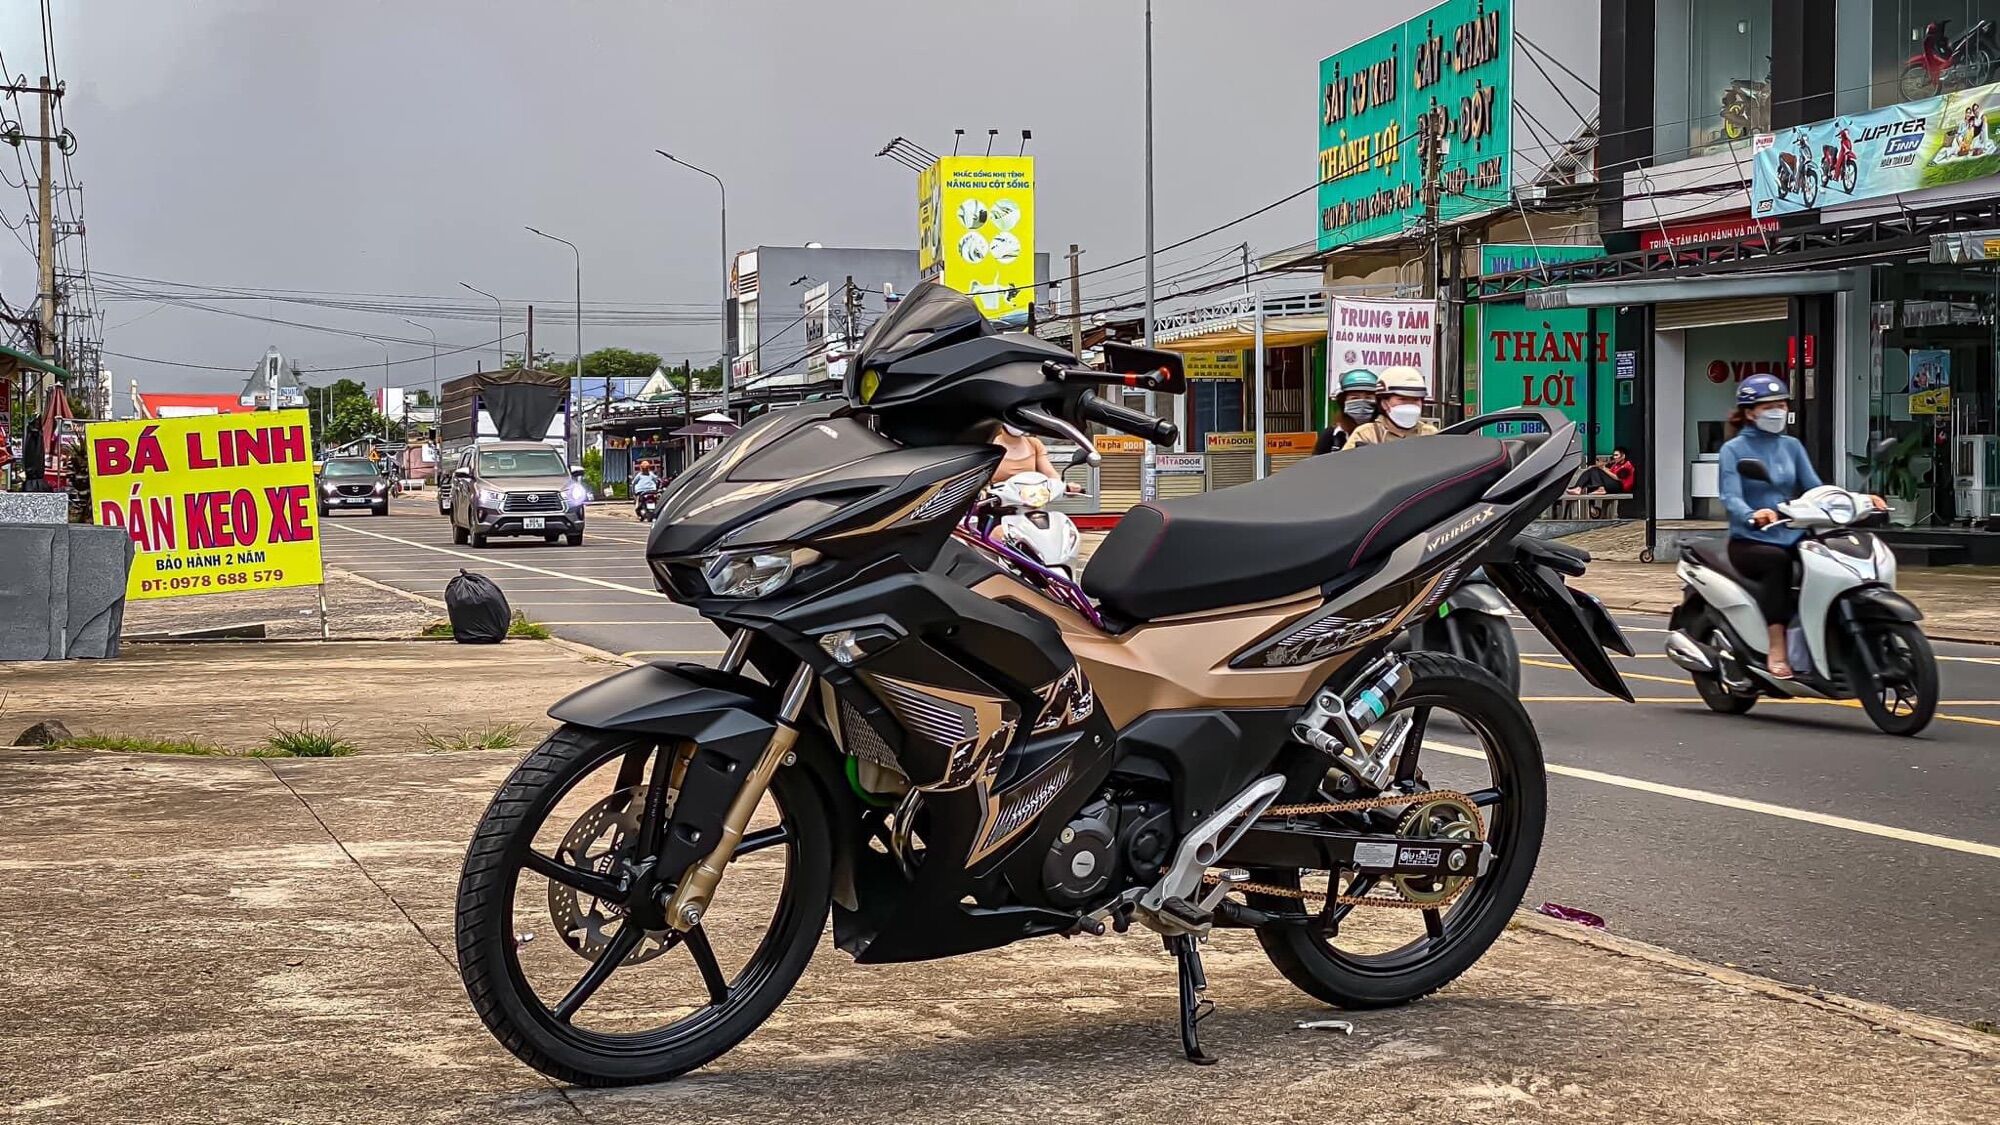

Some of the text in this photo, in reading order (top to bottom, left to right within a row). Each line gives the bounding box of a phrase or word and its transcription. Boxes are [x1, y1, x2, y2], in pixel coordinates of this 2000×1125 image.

[1854, 117, 1926, 143] JUPITER
[1319, 118, 1400, 184] THÀNH LỢI
[1888, 138, 1920, 153] FINN
[946, 179, 971, 188] NÂNG
[972, 180, 987, 189] NIU
[1006, 178, 1030, 189] SỐNG
[1340, 307, 1430, 330] TRUNG TÂM
[1397, 335, 1418, 347] DỊCH
[1420, 335, 1432, 348] VỤ
[1490, 321, 1609, 362] THÀNH
[1361, 350, 1422, 367] YAMAHA
[94, 425, 306, 477] BÁ LINH
[184, 488, 259, 550] KEO
[265, 484, 314, 544] XE
[156, 550, 266, 571] BẢO HÀNH 2 NĂM
[217, 572, 248, 585] 688
[253, 569, 284, 582] 579
[1011, 785, 1055, 819] HONDA
